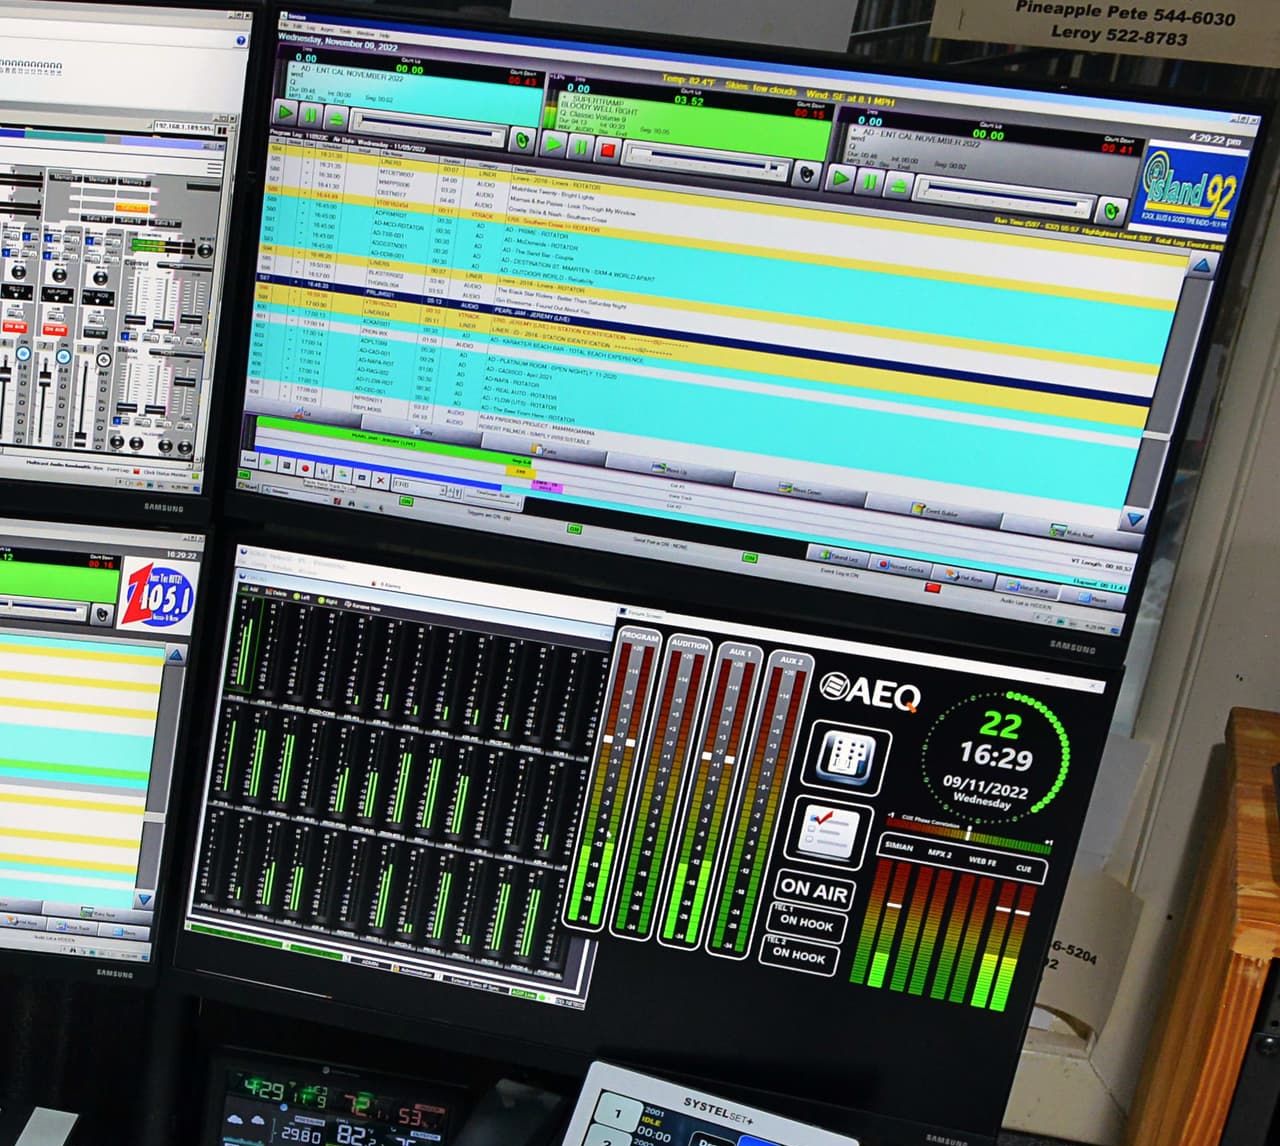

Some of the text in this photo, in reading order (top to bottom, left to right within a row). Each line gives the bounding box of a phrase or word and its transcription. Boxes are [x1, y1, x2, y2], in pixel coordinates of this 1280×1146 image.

[1016, 0, 1236, 27] Pineapple Pete 544-6030
[278, 32, 323, 46] Wednesday,
[325, 38, 362, 49] November
[379, 43, 398, 52] 2022
[1052, 24, 1188, 46] Leroy 522-8783
[769, 86, 798, 96] clouds
[560, 102, 592, 110] BLOODY
[613, 107, 638, 116] RIGHT
[875, 97, 896, 107] MPH
[1148, 169, 1237, 220] island 92
[144, 502, 184, 513] SAMSUNG
[622, 631, 660, 643] PROGRAM
[671, 638, 709, 651] AUDITION
[1050, 640, 1096, 655] SAMSUNG
[729, 647, 746, 657] AUX
[781, 656, 797, 665] AUX
[846, 677, 921, 713] AEQ
[979, 710, 1023, 740] 22
[961, 741, 1033, 772] 16:29
[943, 774, 1029, 800] 09/11/2022
[953, 791, 1012, 812] Wednesday
[885, 841, 914, 852] SIMIAN
[969, 856, 997, 867] WEB FE
[1016, 864, 1032, 873] CUE
[780, 877, 848, 903] ON AIR
[780, 913, 833, 932] ON HOOK
[773, 946, 826, 965] ON HOOK
[96, 969, 134, 979] SAMSUNG
[614, 1108, 621, 1119] 1
[644, 1106, 665, 1118] 2001
[641, 1115, 661, 1127] IDLE
[636, 1126, 671, 1144] 00:00
